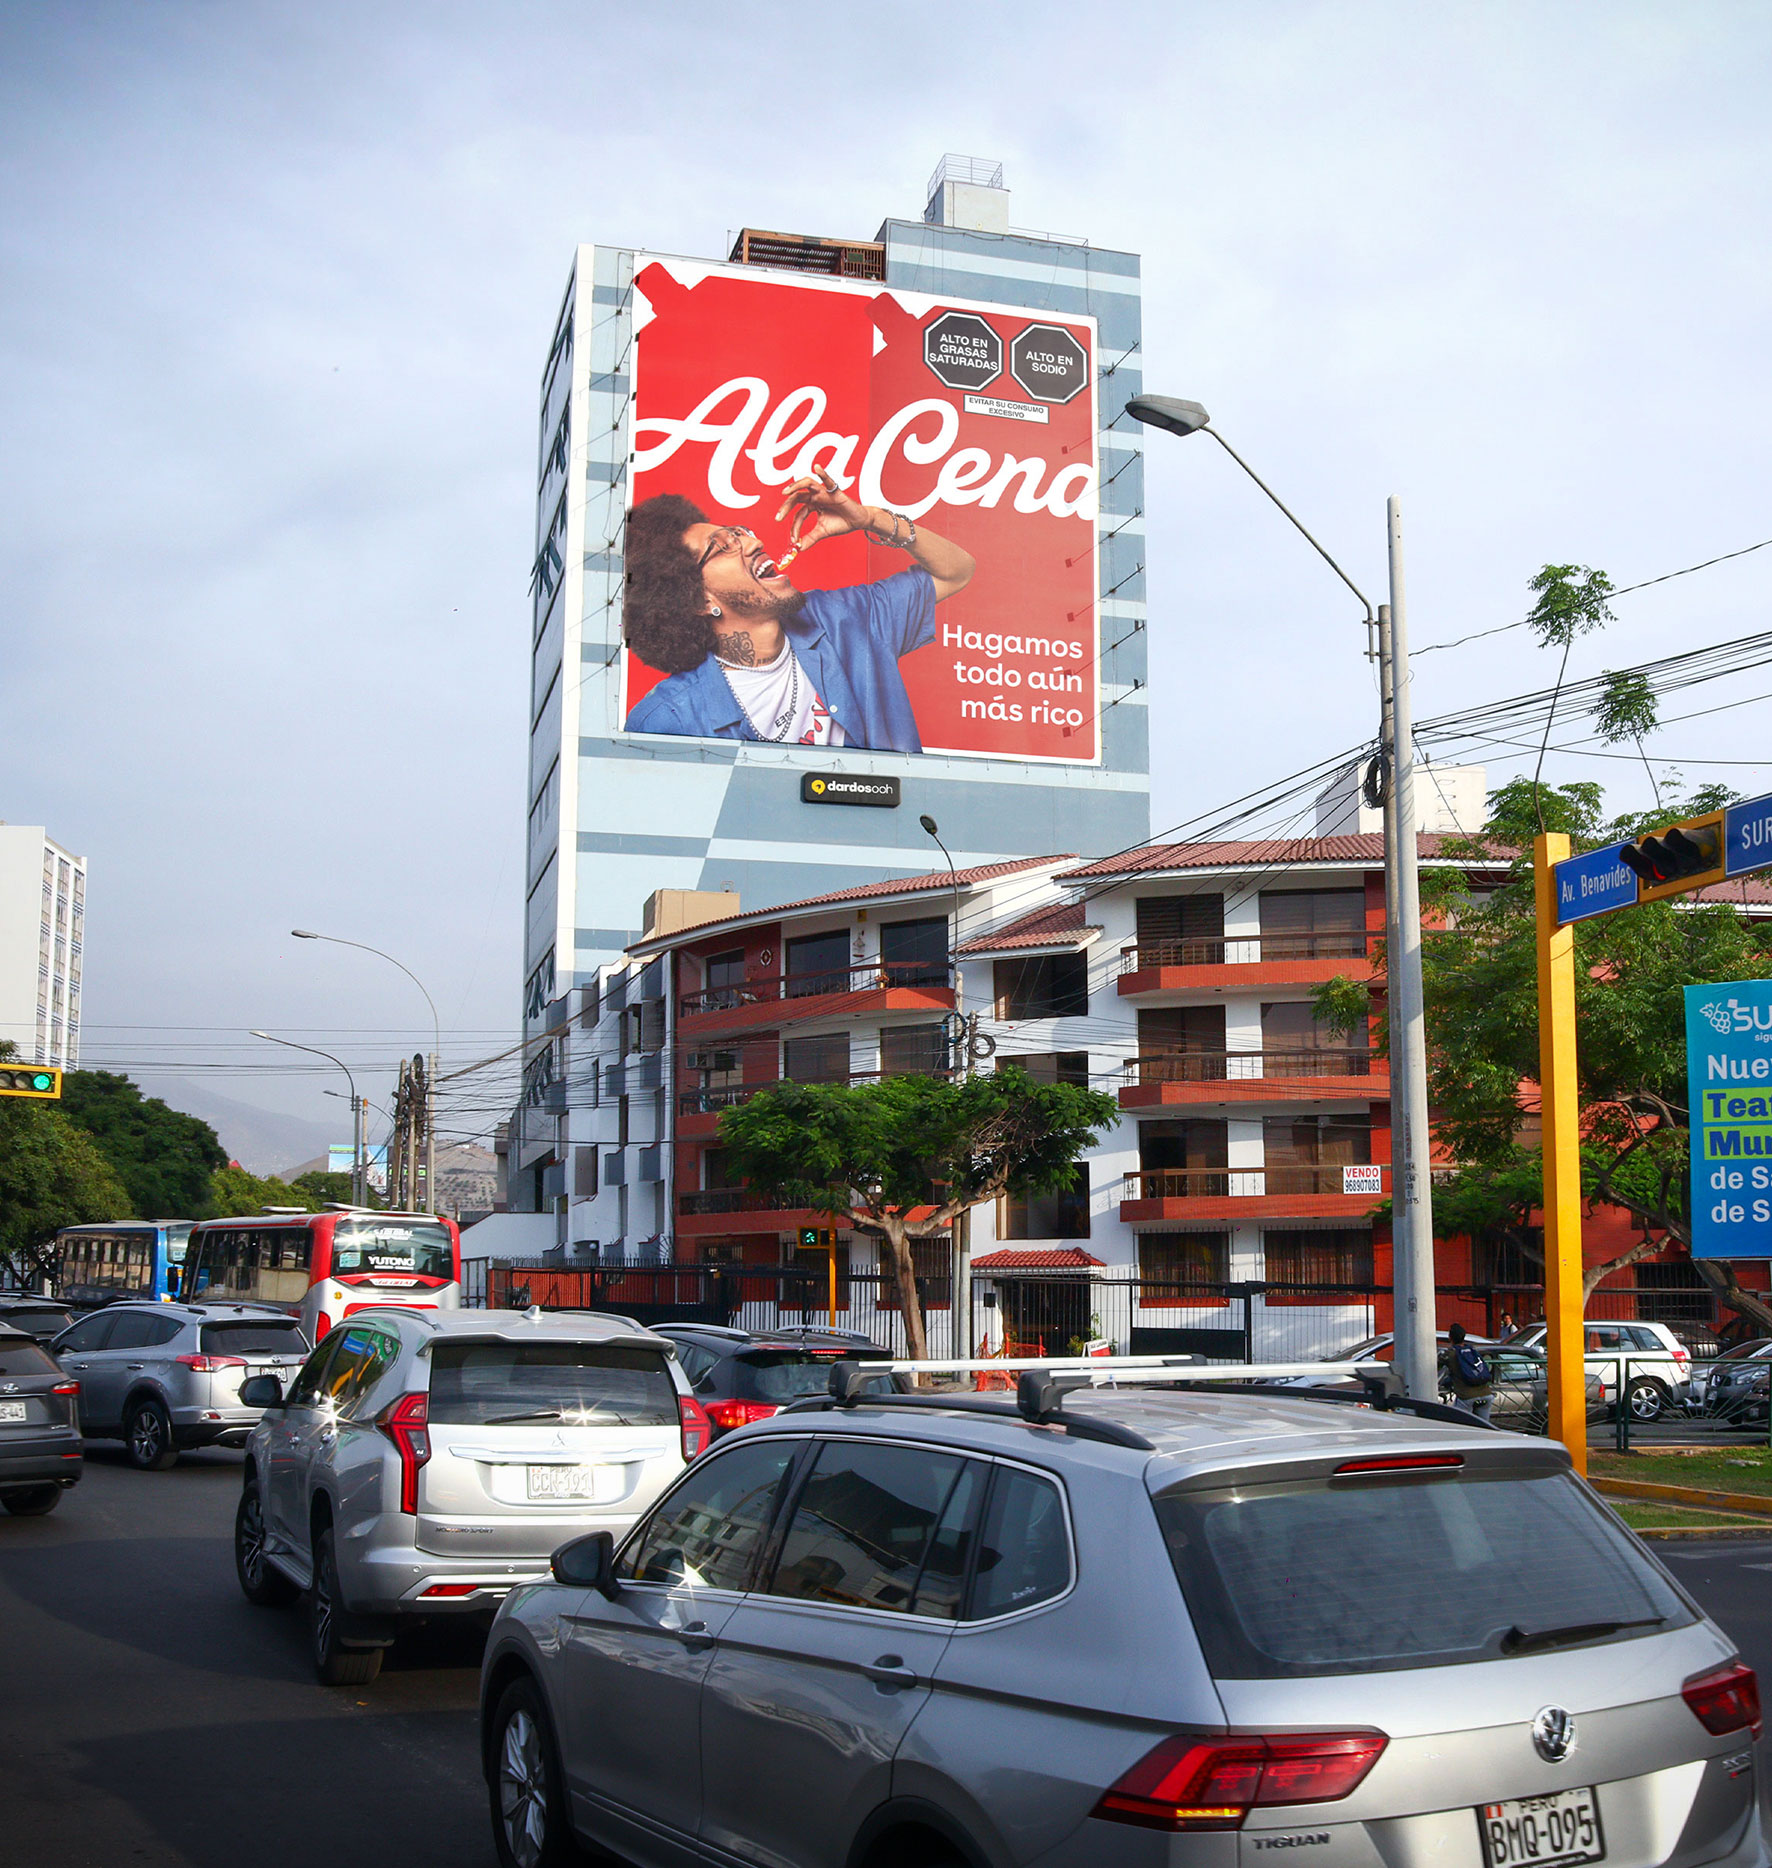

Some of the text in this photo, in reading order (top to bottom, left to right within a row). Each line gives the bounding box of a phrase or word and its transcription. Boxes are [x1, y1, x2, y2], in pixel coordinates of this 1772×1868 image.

[940, 333, 988, 348] ALTO EN
[940, 344, 988, 359] GRASAS
[1025, 351, 1073, 366] ALTO EN
[929, 353, 998, 371] SATURADAS
[1032, 363, 1067, 376] SODIO
[969, 397, 995, 407] EVITAR
[1007, 402, 1044, 414] CONSUMO
[989, 408, 1025, 418] EXCESIVO
[942, 623, 1083, 658] Hagamos
[953, 661, 1083, 693] todo aún
[961, 695, 1084, 726] más rico
[827, 781, 893, 794] dardosooh
[1562, 864, 1631, 904] Av. Benavides
[1754, 1032, 1772, 1043] sig
[1707, 1054, 1772, 1080] Nue
[1707, 1093, 1772, 1118] Tea
[1345, 1167, 1379, 1178] VENDO
[1710, 1165, 1772, 1190] de S
[1711, 1199, 1745, 1223] de
[368, 1256, 415, 1267] YUTONG
[1251, 1831, 1331, 1850] TIGUAN
[1490, 1804, 1593, 1864] BMQ-095
